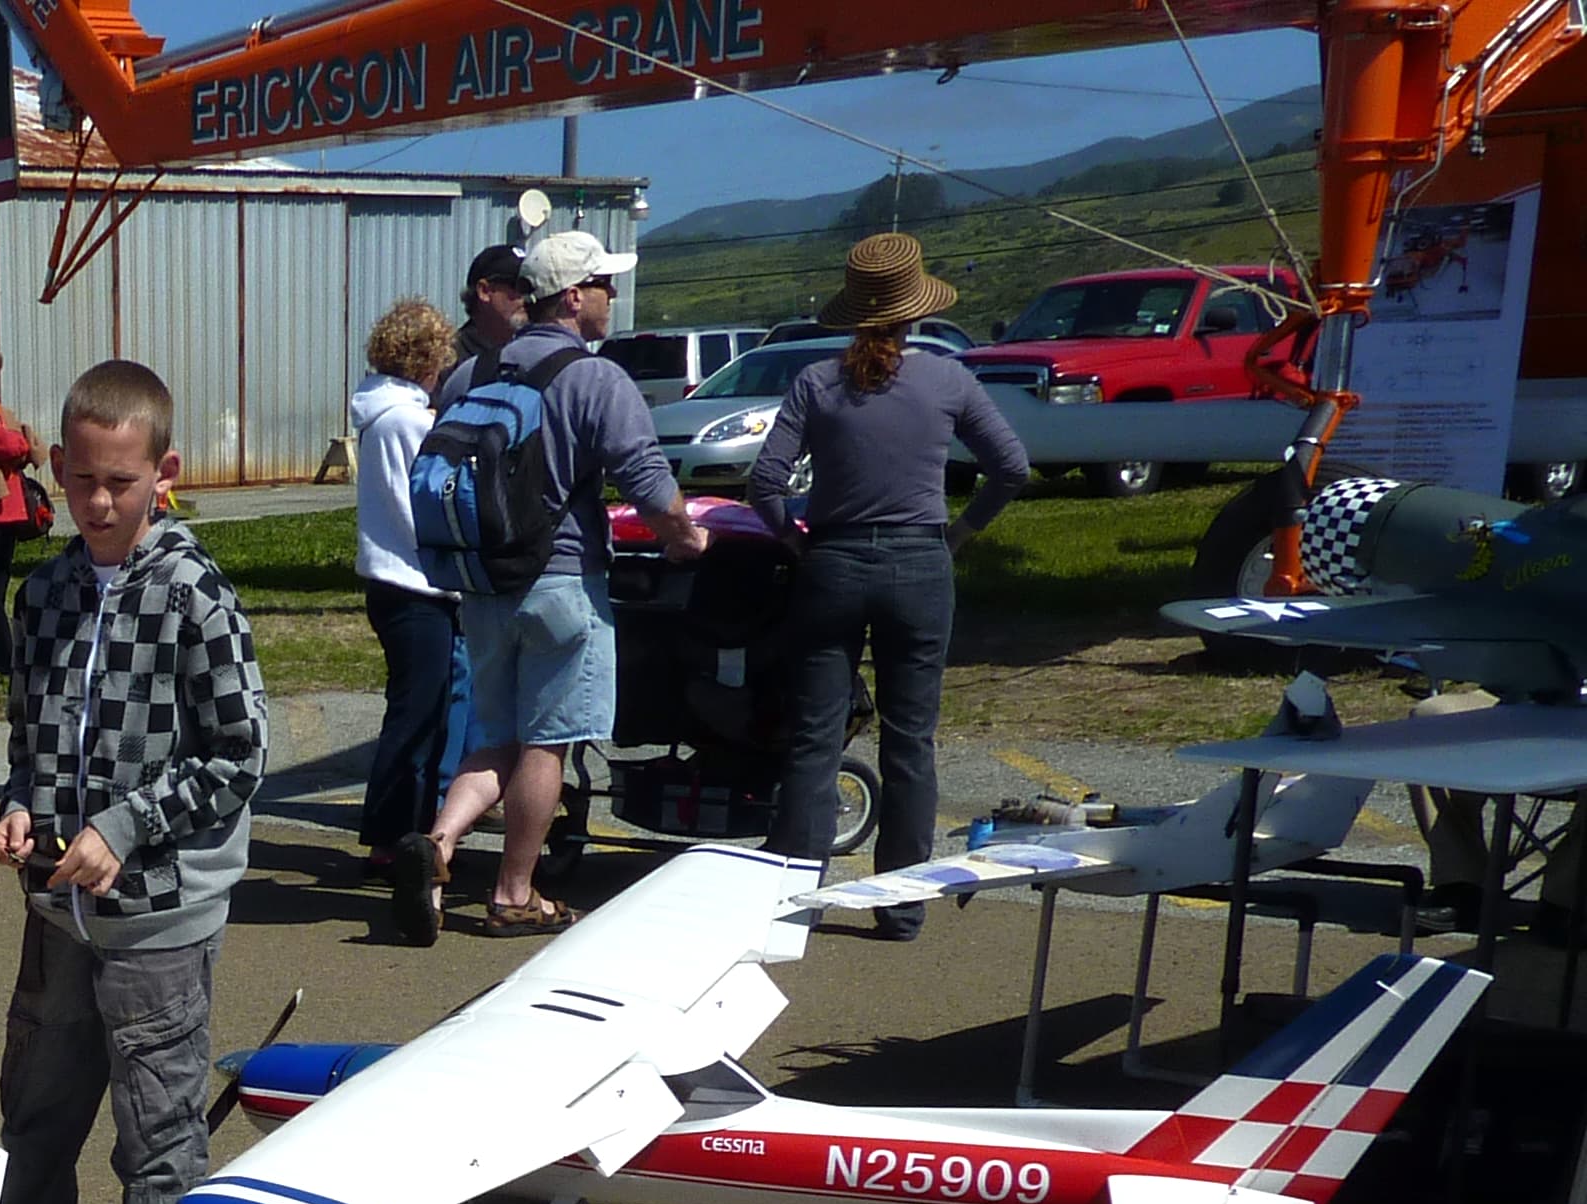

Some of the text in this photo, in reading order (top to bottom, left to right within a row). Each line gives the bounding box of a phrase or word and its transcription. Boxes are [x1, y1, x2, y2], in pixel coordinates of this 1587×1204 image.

[191, 0, 765, 144] ERICKSON AIR-CRANE
[701, 1136, 765, 1155] cessna
[825, 1144, 1050, 1204] N25909
